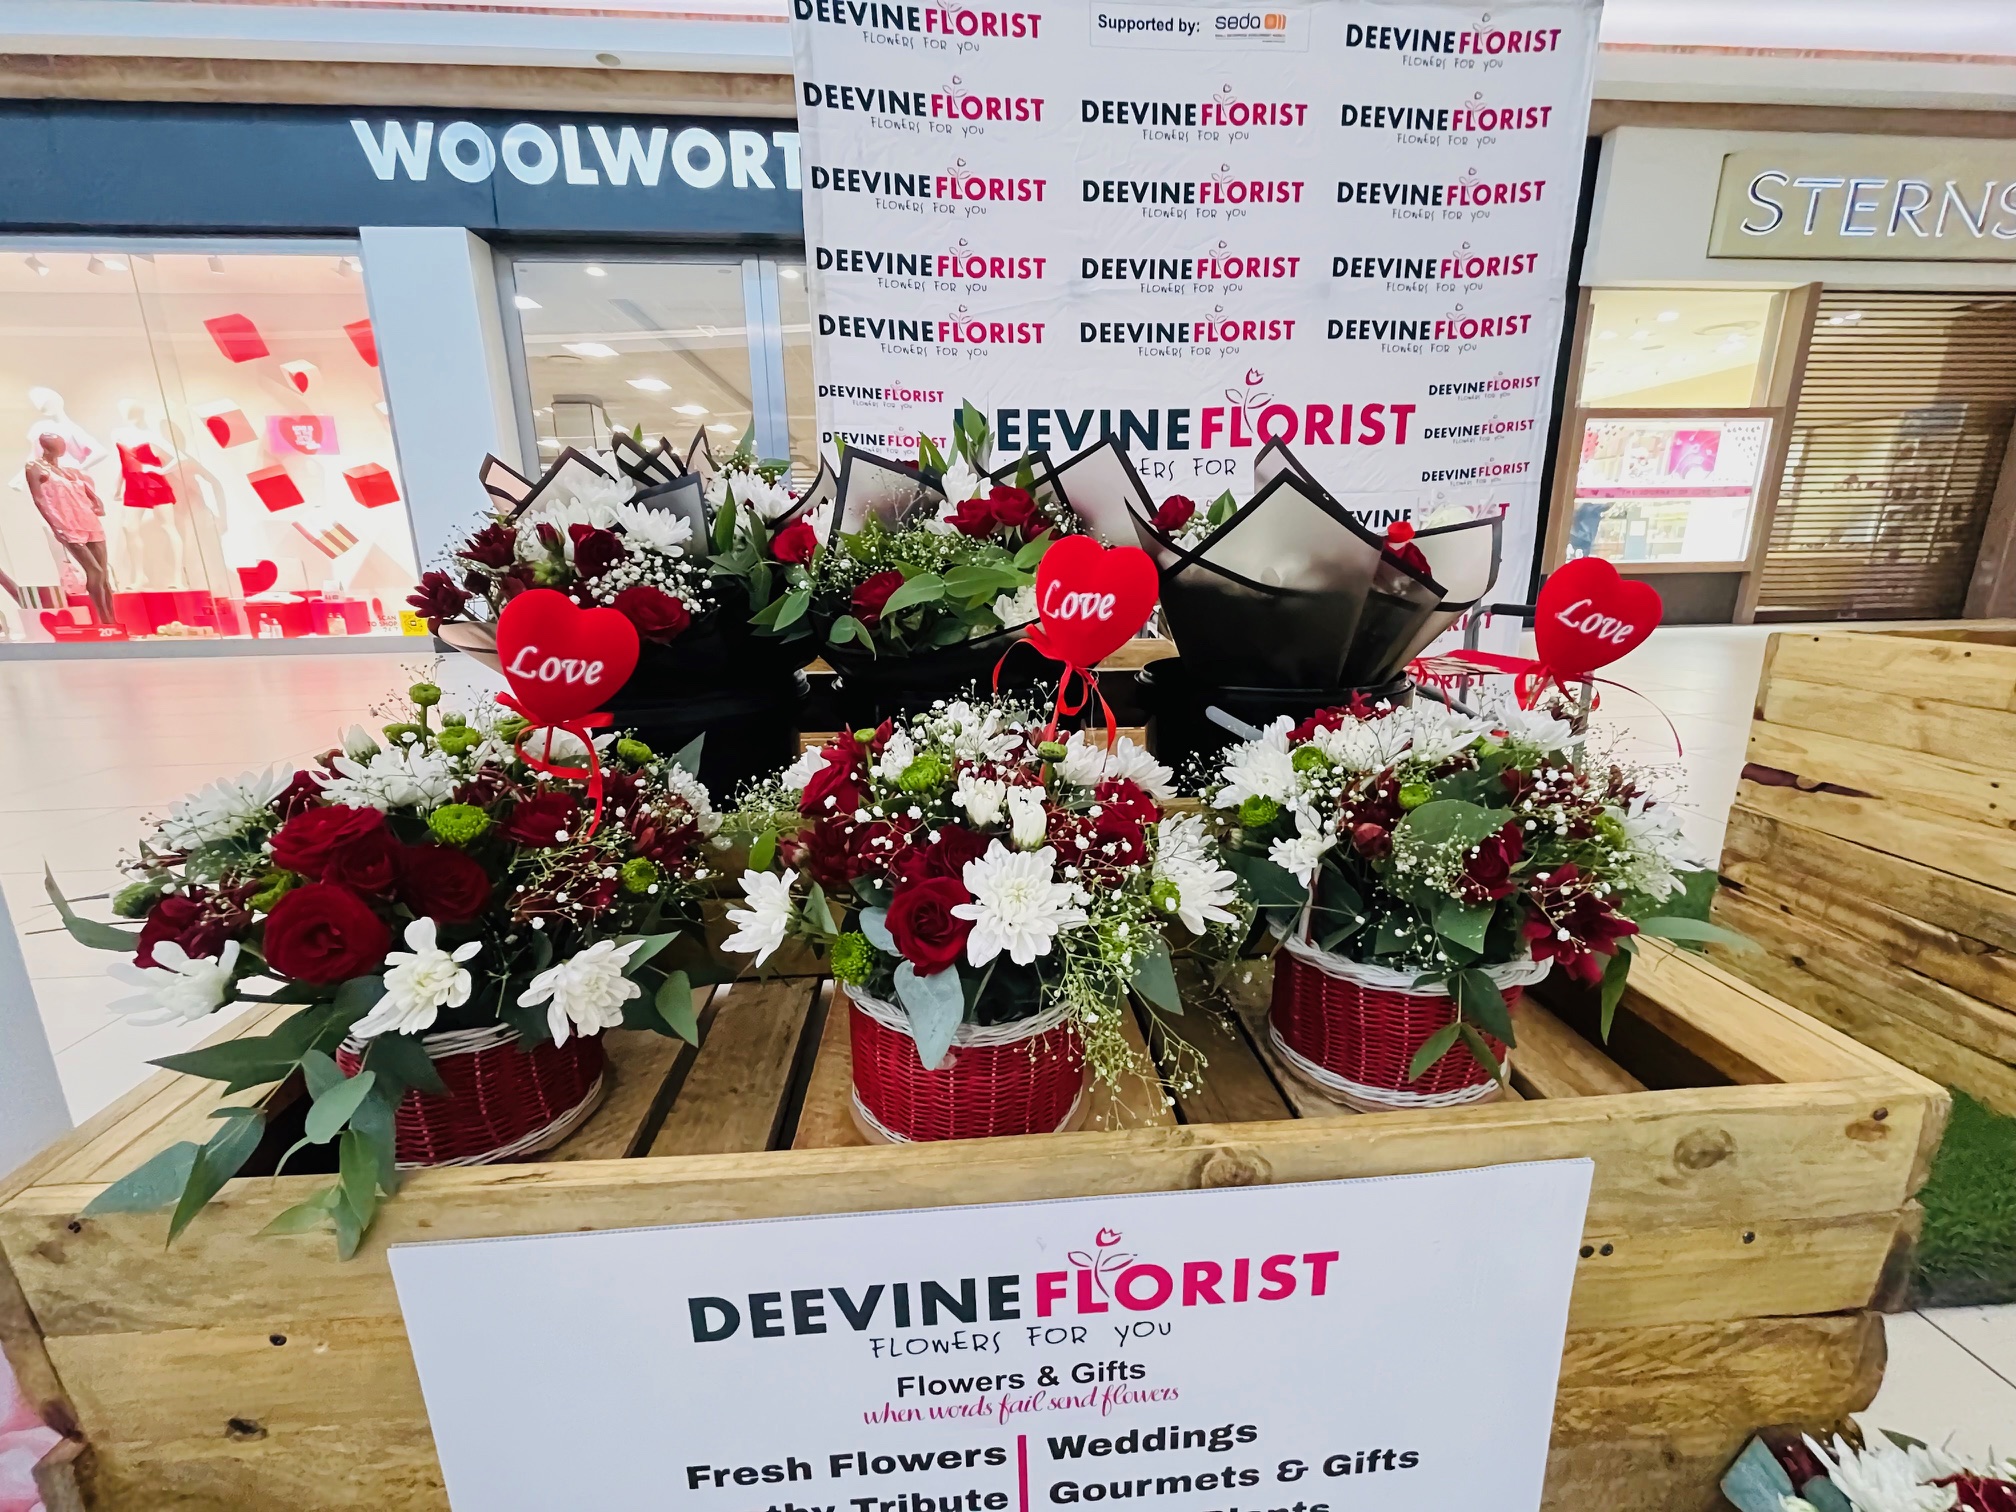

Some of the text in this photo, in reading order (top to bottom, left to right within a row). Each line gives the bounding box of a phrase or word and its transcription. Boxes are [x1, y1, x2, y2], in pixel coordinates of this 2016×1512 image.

[1098, 14, 1199, 36] Supported by:
[863, 31, 979, 55] FLOWERS FOR YOU
[1455, 58, 1475, 69] FOR
[871, 116, 984, 138] FLOWERS FOR YOU
[1143, 129, 1249, 144] FLOWERS FOR YOU
[875, 198, 986, 218] FLOWERS FOR YOU
[1142, 207, 1246, 221] FLOWERS FOR YOU
[878, 277, 987, 295] FLOWERS FOR YOU
[1141, 283, 1242, 295] FLOWERS FOR YOU
[881, 343, 987, 360] FLOWERS FOR YOU
[1138, 346, 1239, 358] FLOWERS FOR YOU
[1193, 458, 1236, 476] FOR
[1042, 579, 1116, 623] Love
[1554, 599, 1635, 644] Love
[506, 645, 604, 685] Love
[870, 1322, 1171, 1359] FLOWERS FOR YOU
[898, 1360, 1146, 1398] Flowers & Gifts
[863, 1384, 1179, 1425] when words fail send flowers
[1047, 1424, 1257, 1460] Weddings
[686, 1443, 1007, 1490] Fresh Flowers
[1050, 1447, 1419, 1504] Gourmets & Gifts
[850, 1489, 1008, 1512] Tribute
